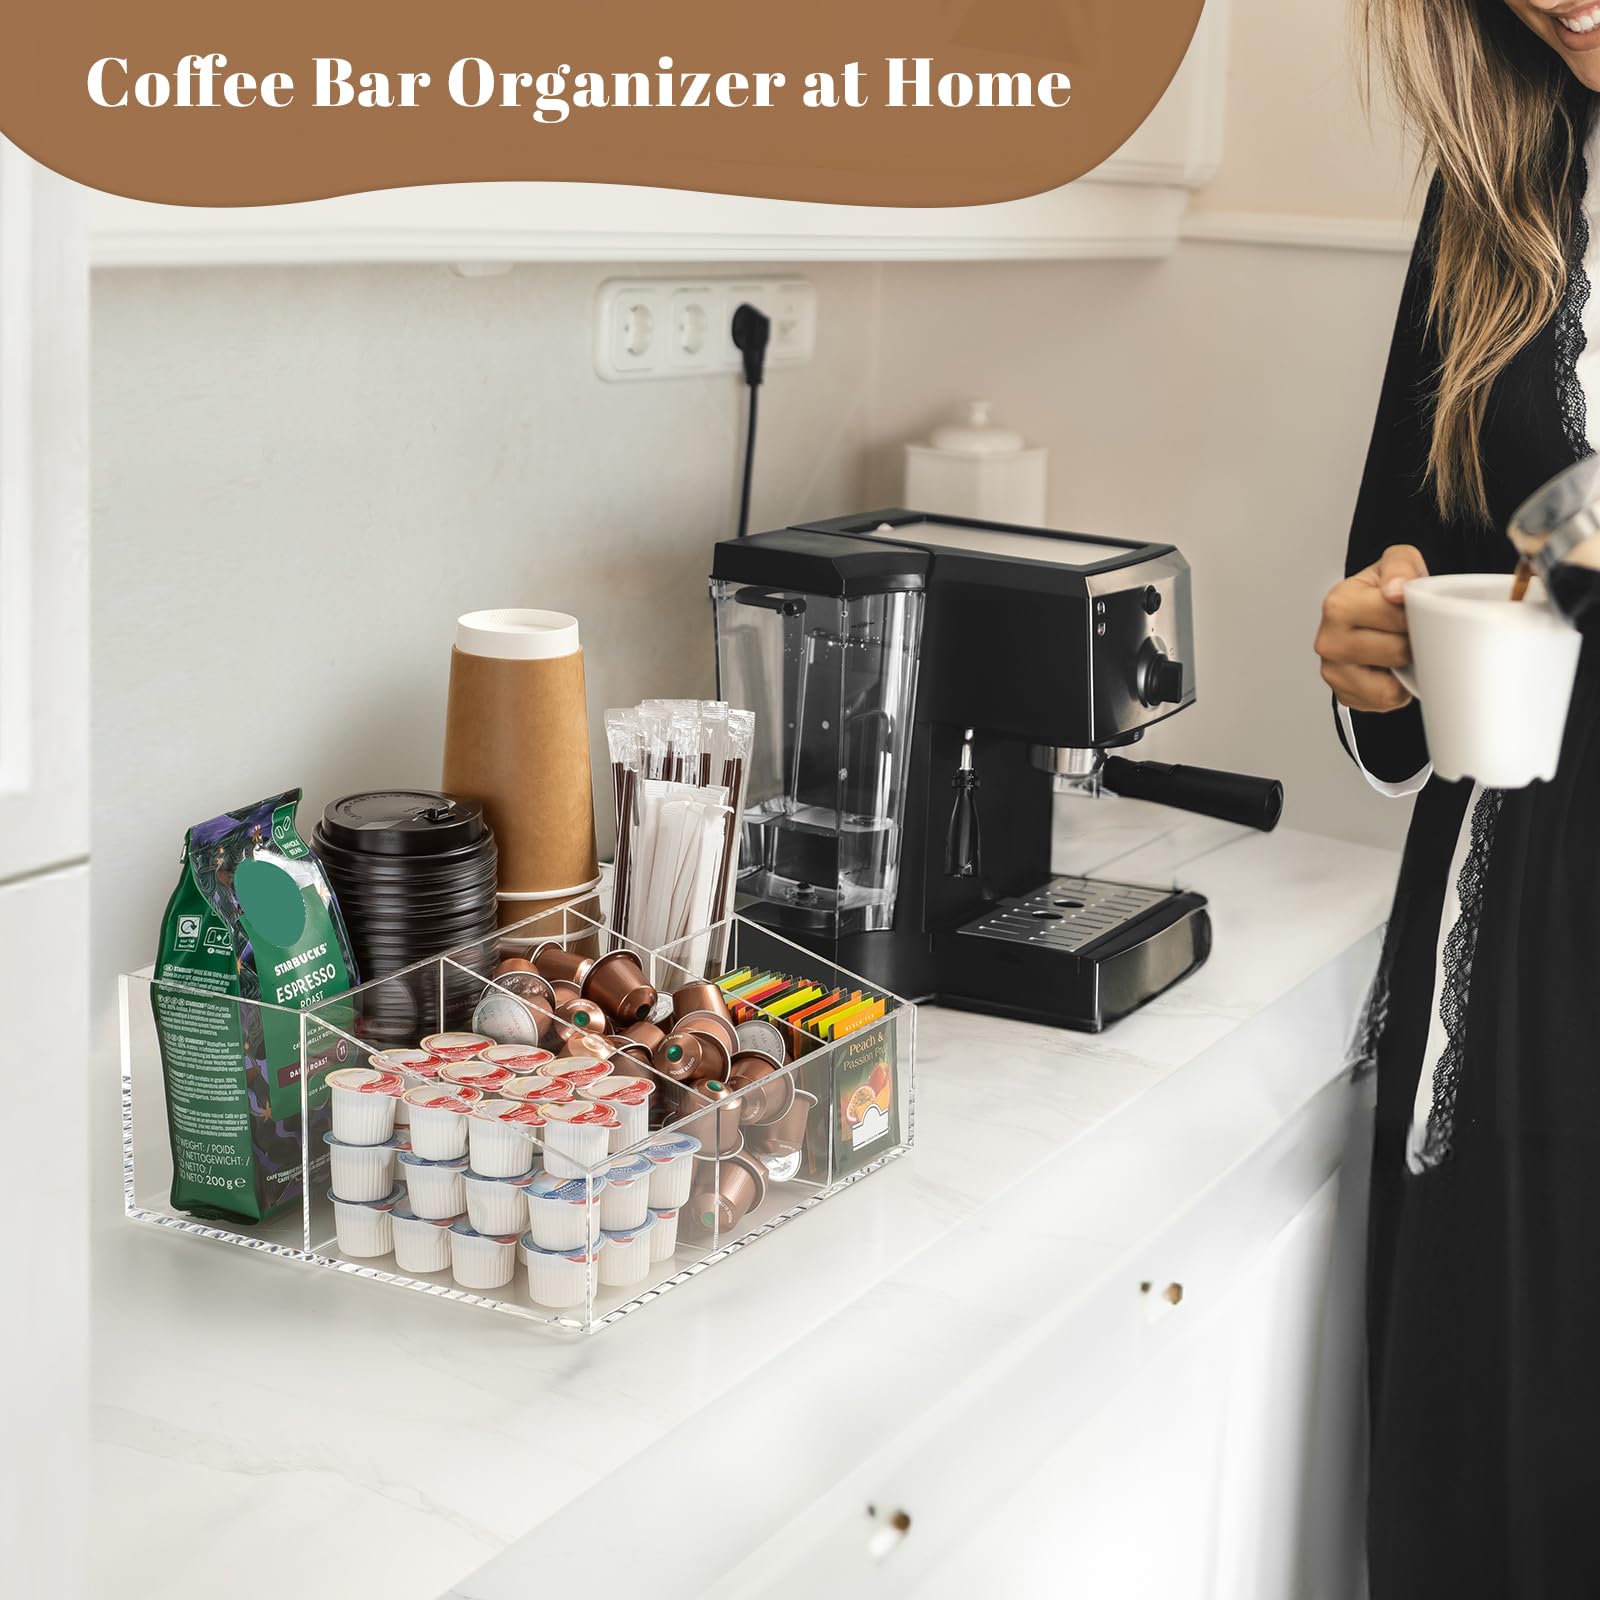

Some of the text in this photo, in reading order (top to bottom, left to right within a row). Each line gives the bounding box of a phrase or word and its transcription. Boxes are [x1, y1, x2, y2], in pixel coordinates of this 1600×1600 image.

[282, 840, 300, 850] WHOLE
[289, 847, 303, 856] BEAN
[274, 944, 327, 976] STARBUCKS
[276, 963, 336, 1004] ESPRESSO
[300, 991, 324, 1009] ROAST
[845, 1020, 863, 1031] BLACK
[292, 1035, 322, 1051] CAMELLY
[849, 1031, 885, 1056] Peach &
[309, 1056, 328, 1071] ROAST
[670, 1056, 696, 1076] HOUSE BLEND
[843, 1051, 874, 1071] Passion
[211, 1144, 236, 1155] POIDS
[185, 1150, 245, 1166] NETTOGEWICHT:
[185, 1160, 208, 1174] NETTO:
[186, 1170, 206, 1184] NETO:
[205, 1175, 226, 1187] 200
[226, 1180, 233, 1190] g
